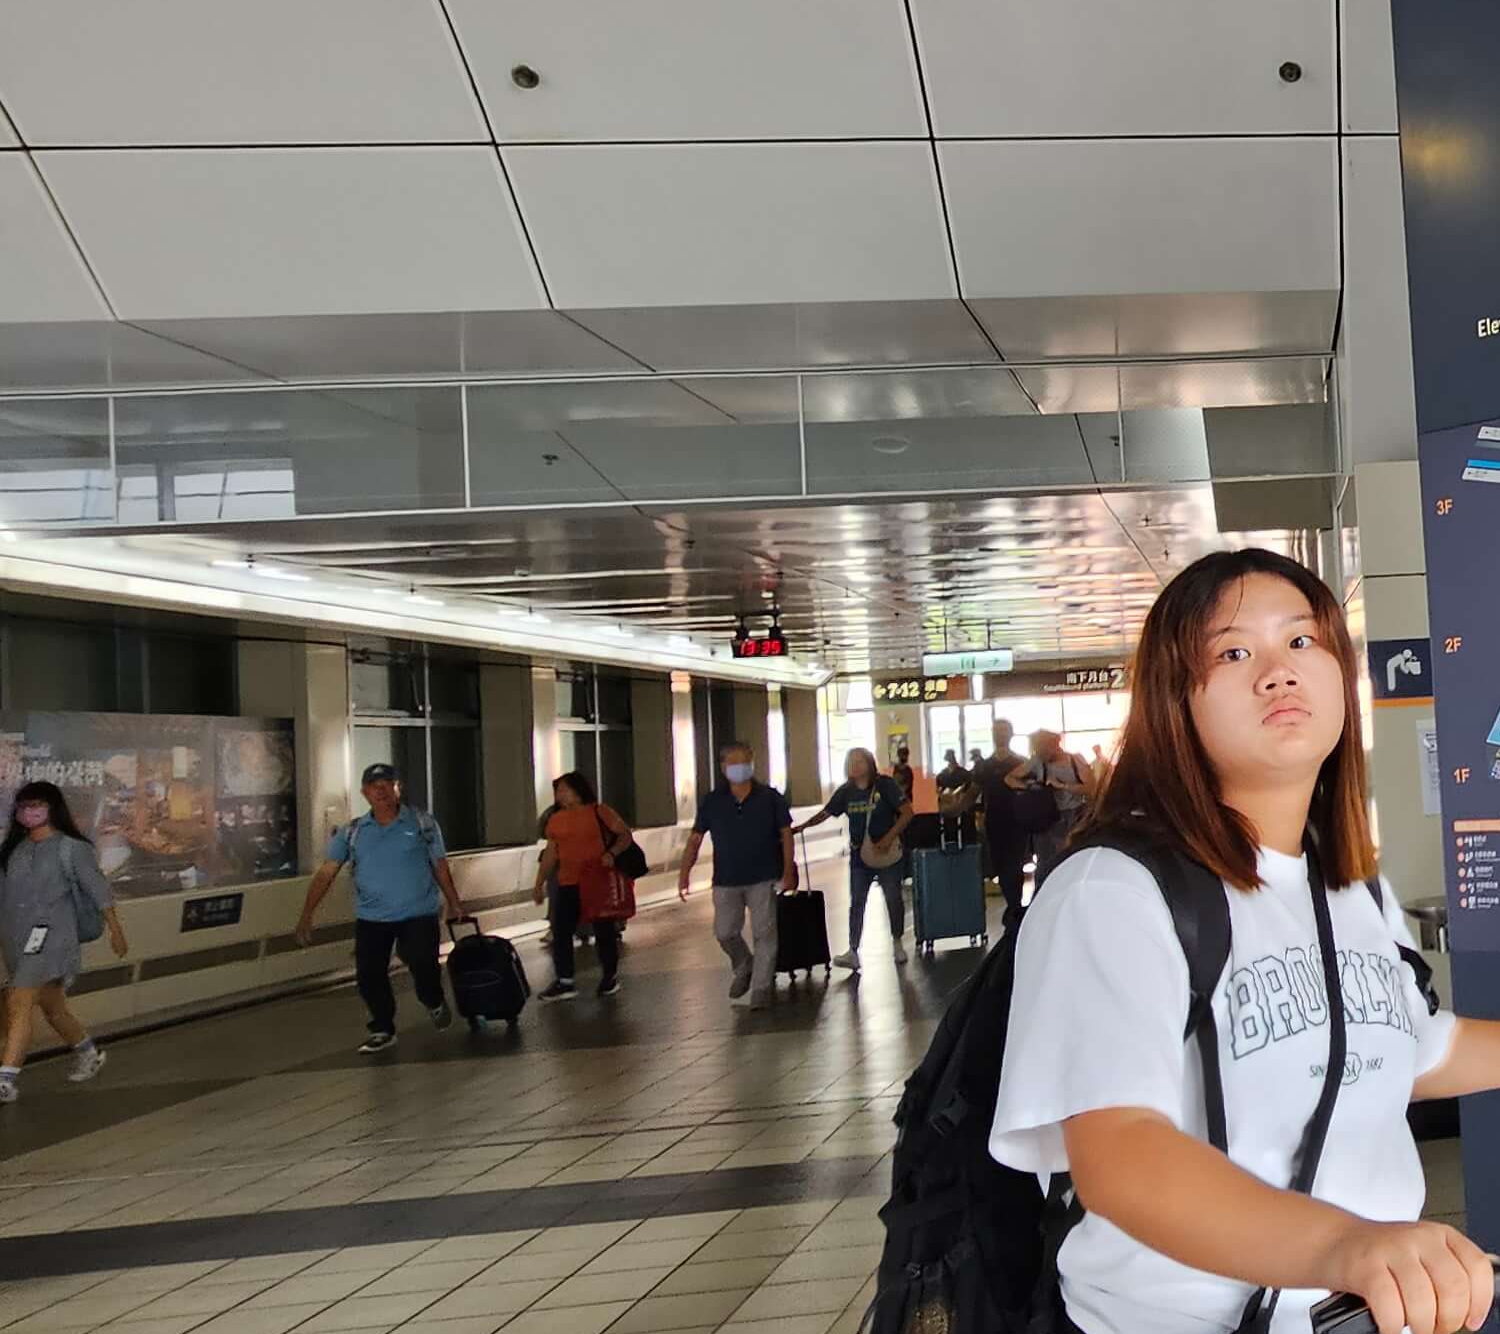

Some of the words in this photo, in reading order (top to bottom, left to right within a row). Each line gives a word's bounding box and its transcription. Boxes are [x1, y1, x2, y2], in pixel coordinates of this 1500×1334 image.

[1436, 499, 1453, 516] 3F
[1444, 637, 1463, 654] 2F
[1110, 668, 1125, 689] 2
[1453, 768, 1471, 784] 1F
